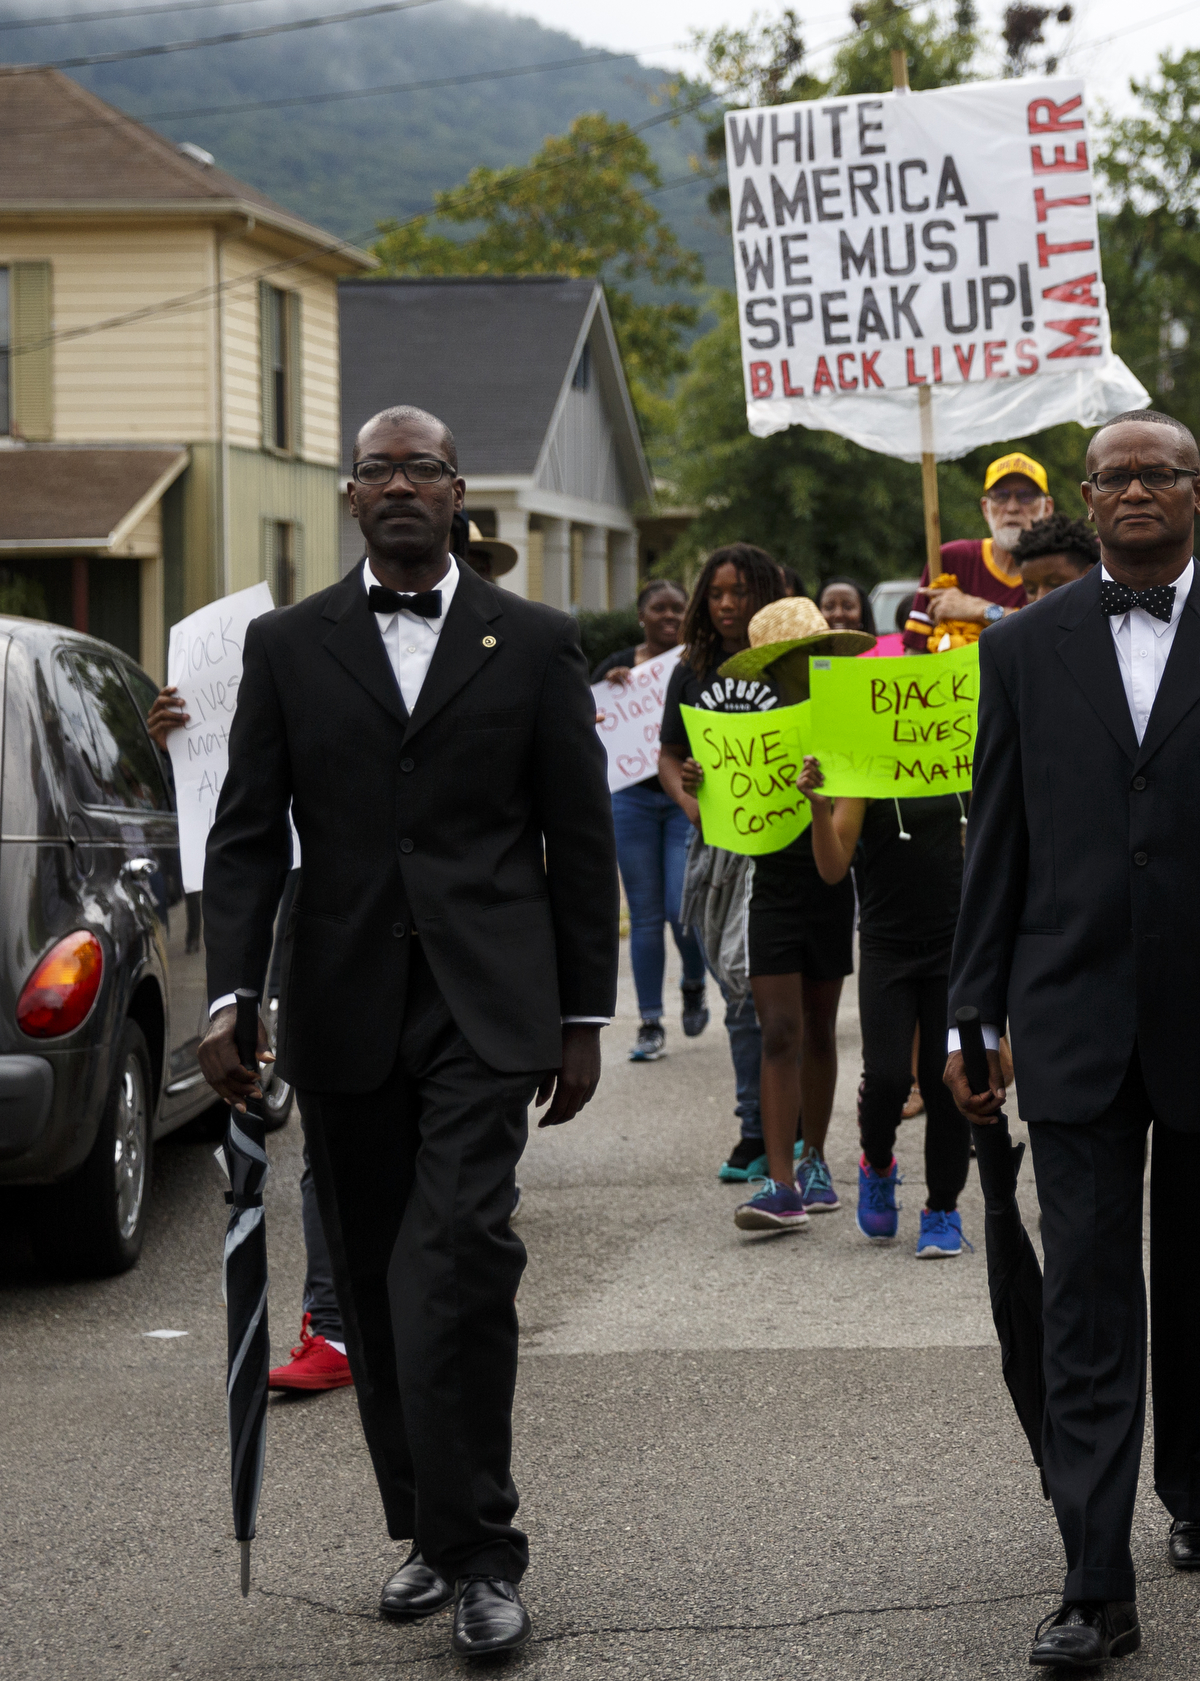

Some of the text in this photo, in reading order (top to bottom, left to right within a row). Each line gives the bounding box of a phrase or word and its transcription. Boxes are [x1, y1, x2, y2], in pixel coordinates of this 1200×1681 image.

[729, 101, 887, 168] WHITE
[737, 155, 968, 231] AMERICA
[1027, 94, 1103, 360] MATTER
[739, 213, 999, 291] WE MUST
[745, 263, 1035, 349] SPEAK UP!
[749, 339, 1040, 399] BLACK LIVES
[703, 727, 788, 770] SAVE
[730, 763, 798, 798] OUR
